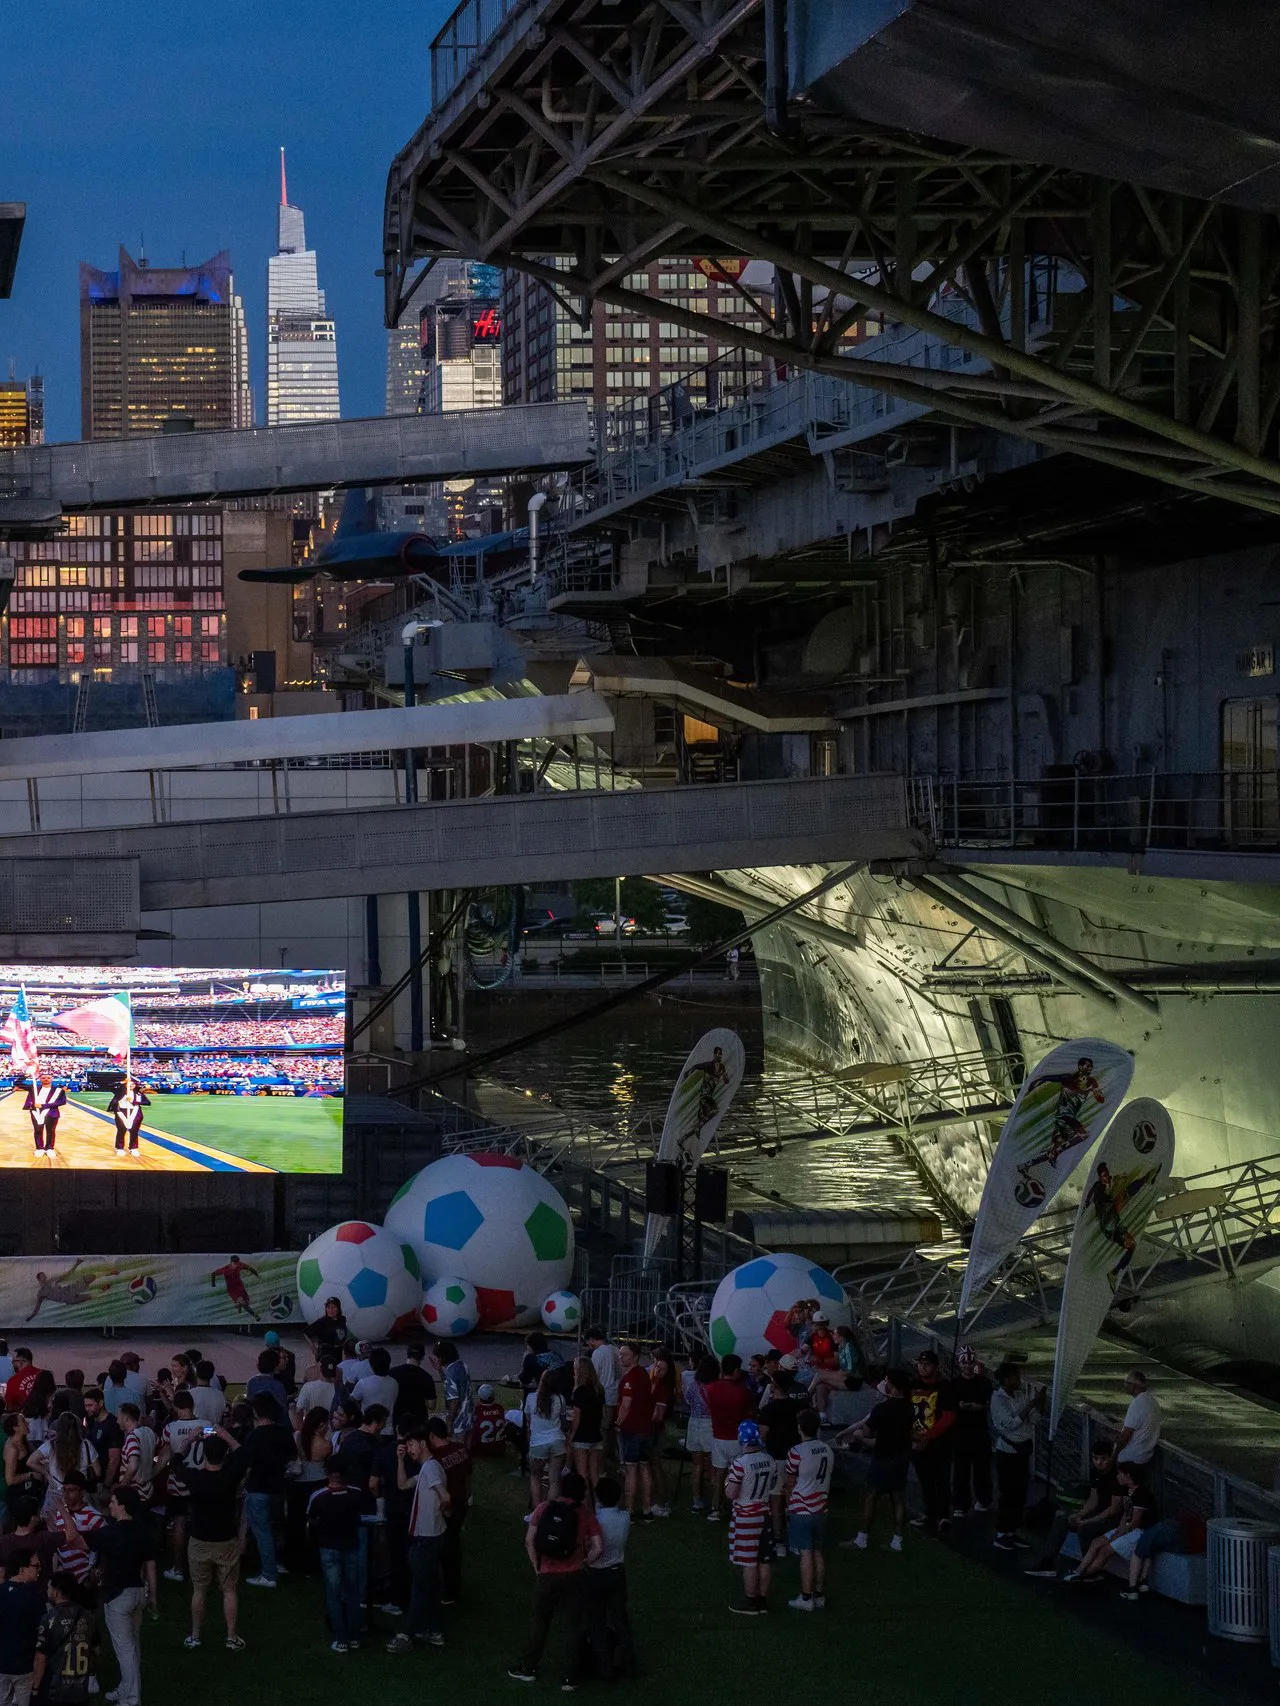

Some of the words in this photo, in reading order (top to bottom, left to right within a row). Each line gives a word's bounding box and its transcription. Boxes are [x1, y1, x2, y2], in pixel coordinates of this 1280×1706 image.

[473, 309, 501, 337] H&
[479, 1419, 509, 1444] 22
[816, 1457, 827, 1484] 4
[750, 1471, 770, 1500] 17
[61, 1641, 89, 1676] 16
